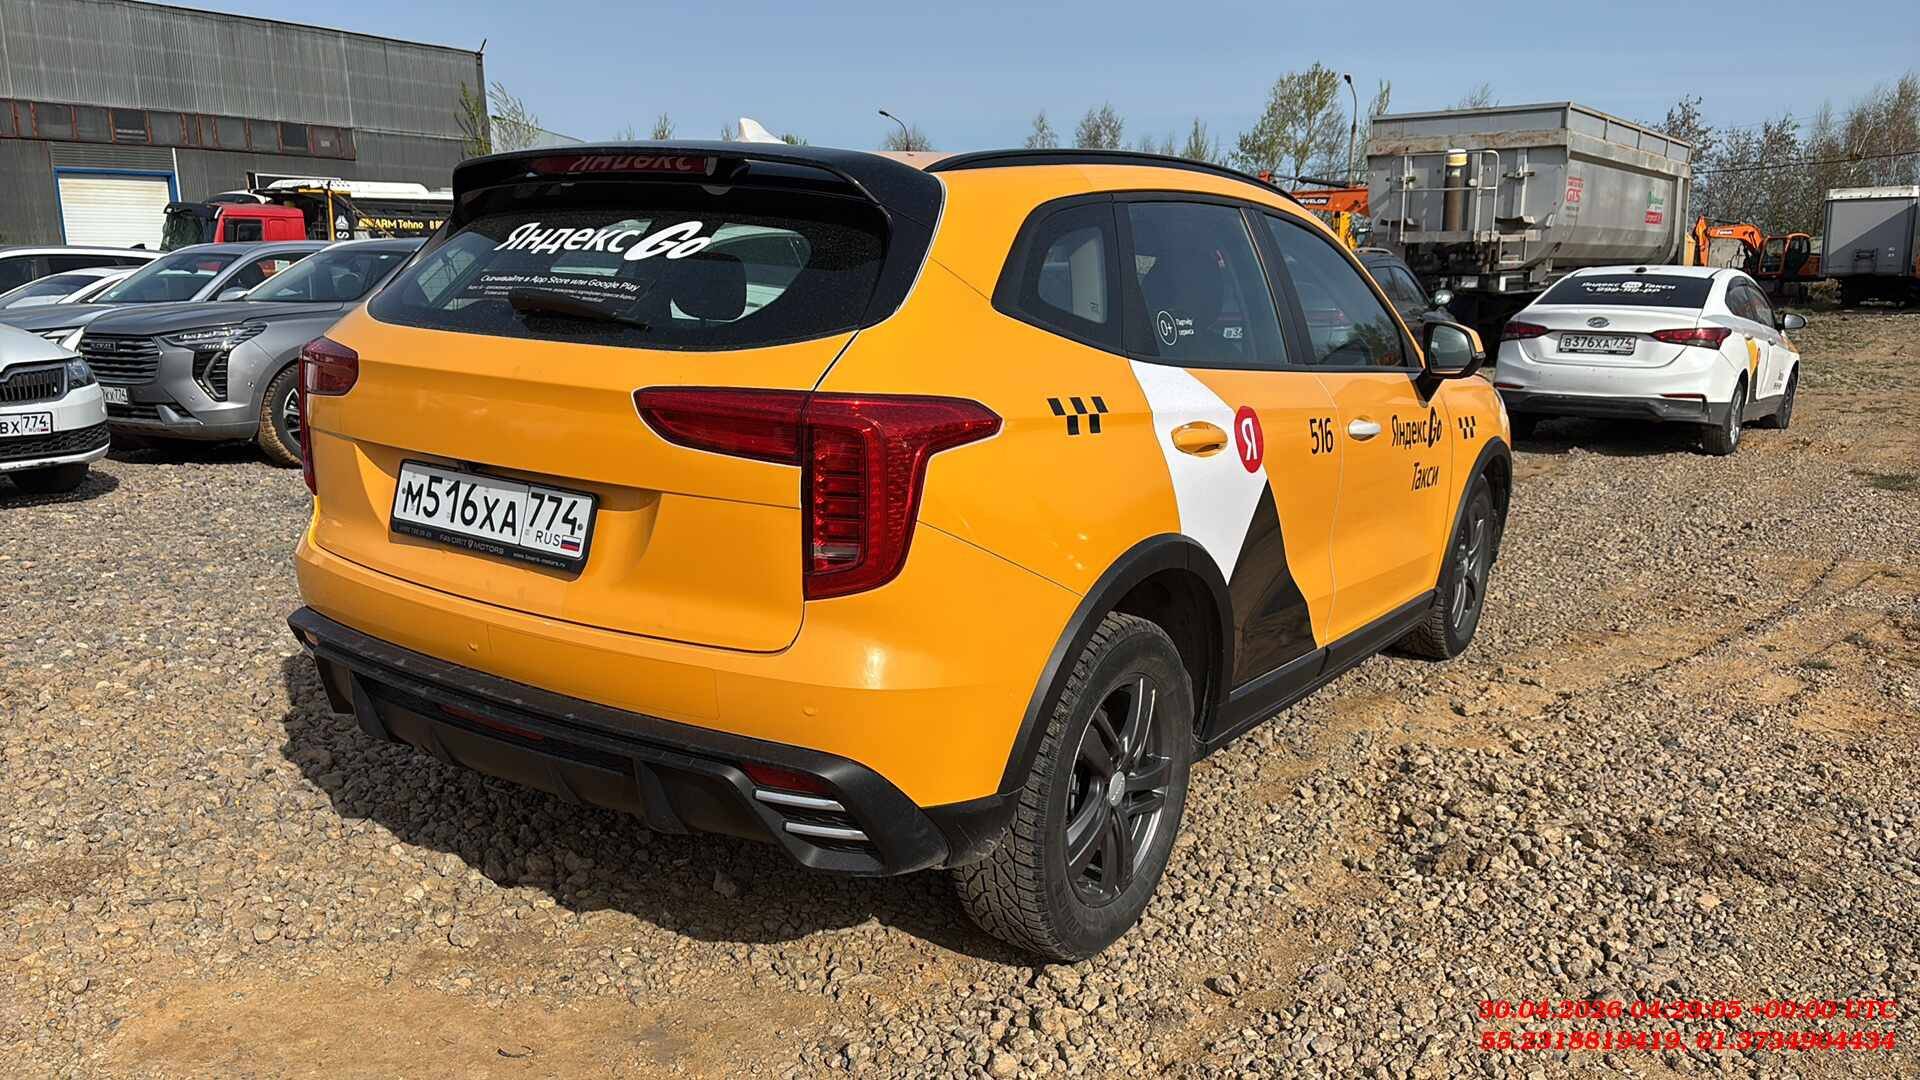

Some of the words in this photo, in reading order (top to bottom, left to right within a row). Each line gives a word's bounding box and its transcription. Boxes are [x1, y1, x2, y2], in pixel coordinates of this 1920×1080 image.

[398, 219, 424, 229] Tehno
[494, 222, 641, 254] Яндекс
[624, 221, 711, 261] Go
[530, 276, 547, 284] App
[549, 276, 568, 285] Store
[588, 279, 619, 289] Google
[621, 282, 640, 292] Play
[1160, 320, 1173, 336] 0+
[23, 415, 47, 428] 774
[1392, 414, 1427, 449] Яндекс
[1427, 406, 1443, 448] Go
[1242, 418, 1258, 461] Я
[1309, 418, 1333, 454] 516
[1411, 462, 1440, 491] Такси
[403, 475, 516, 536] М516ХА
[529, 492, 579, 535] 774
[473, 541, 505, 555] MOTORS
[535, 530, 561, 546] RUS
